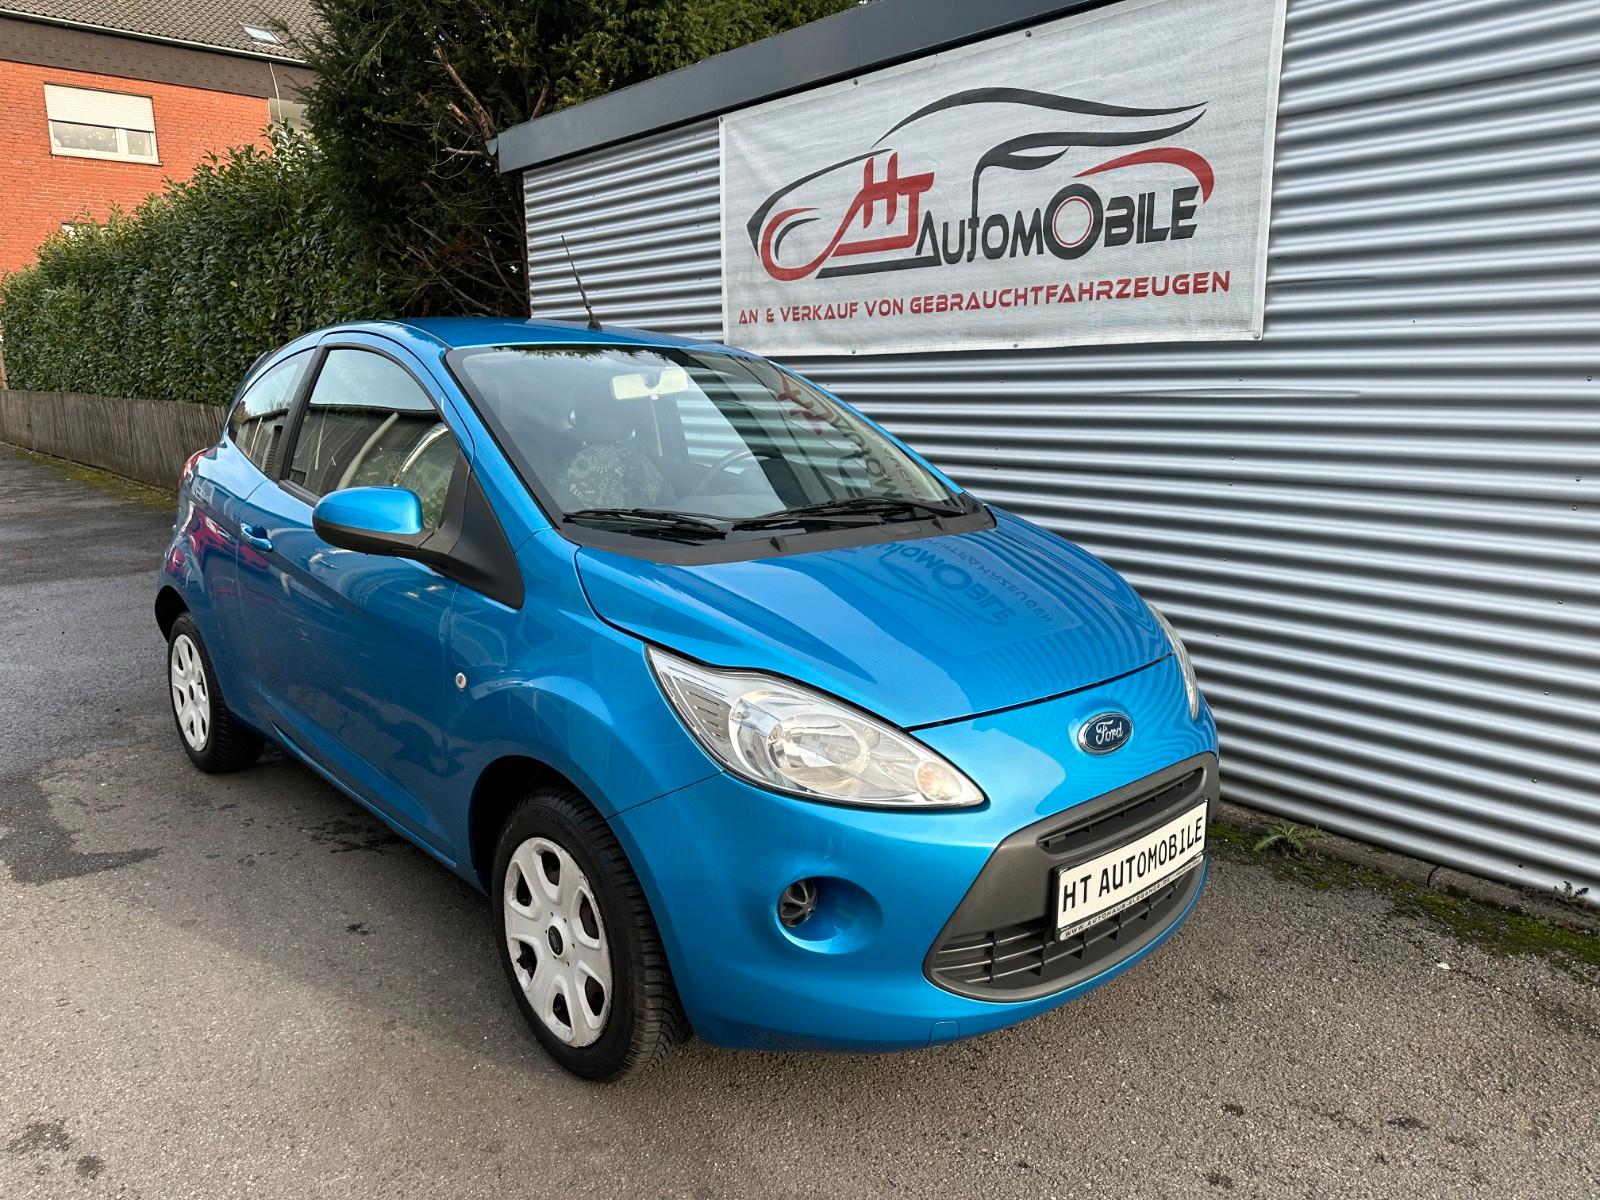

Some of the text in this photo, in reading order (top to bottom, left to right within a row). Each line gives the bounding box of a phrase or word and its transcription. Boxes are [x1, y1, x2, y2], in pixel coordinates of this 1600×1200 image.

[738, 269, 1231, 325] AN & VERKAUF VON GEBRAUCHTFAHRZEUGEN
[1095, 719, 1124, 745] Ford
[1062, 816, 1203, 913] HT AUTOMOBILE
